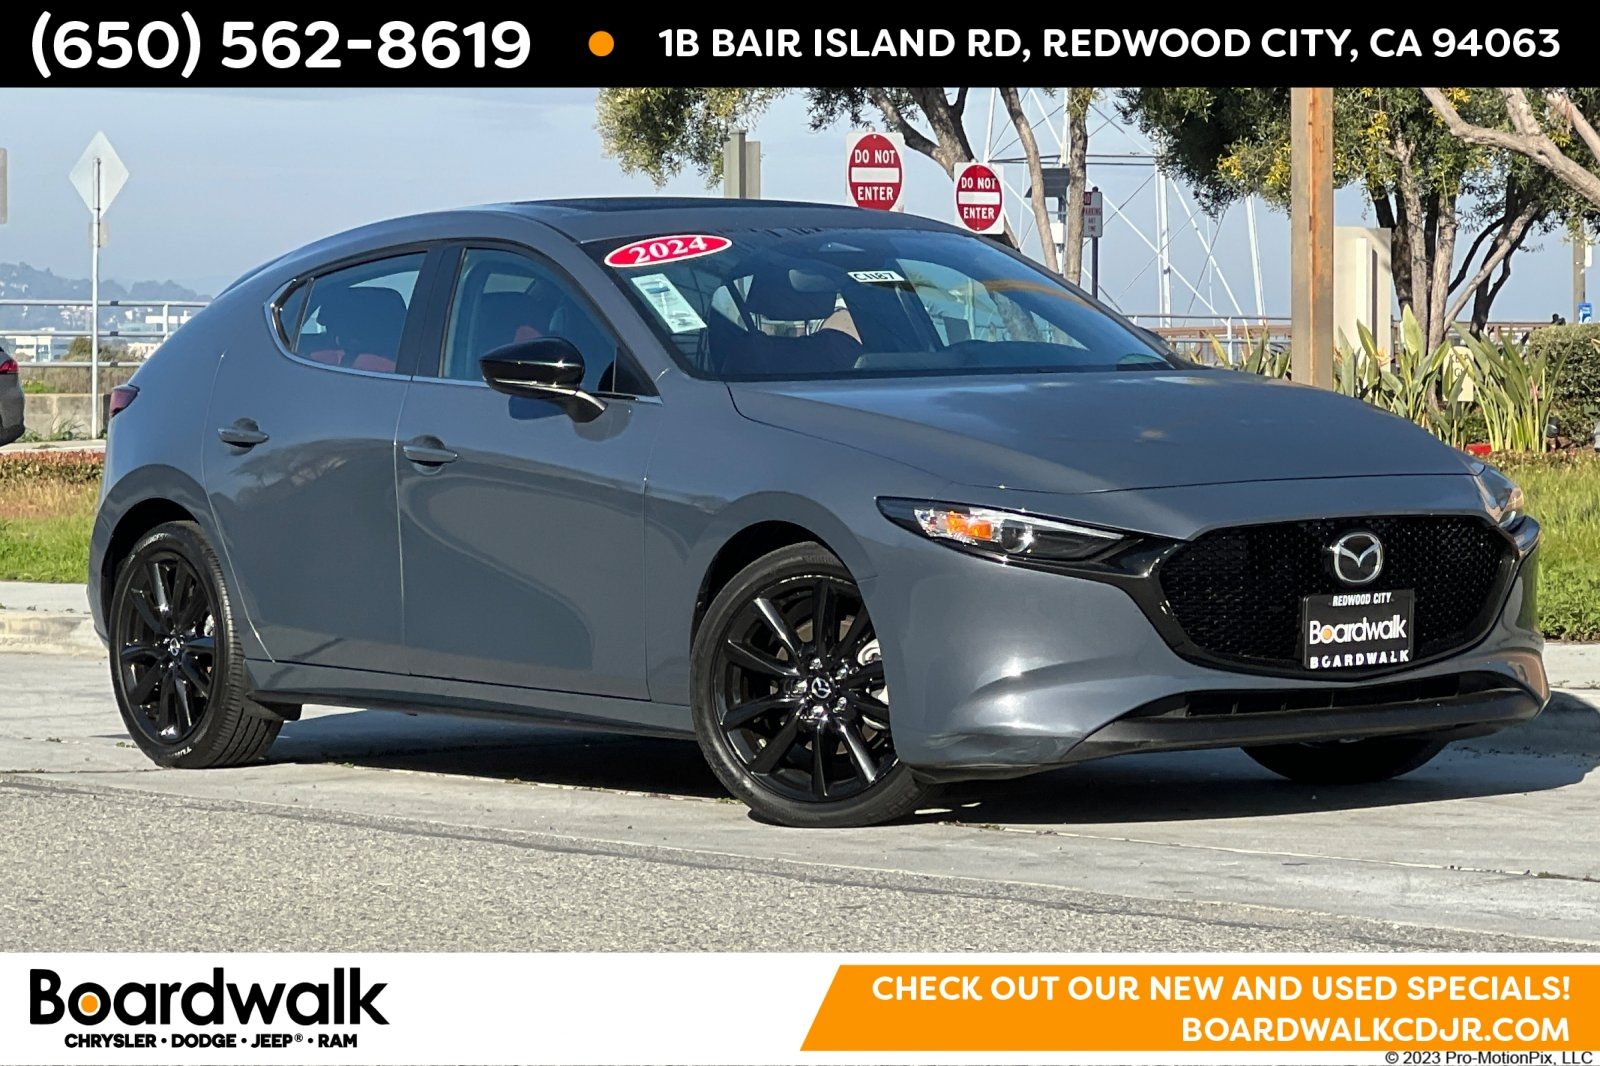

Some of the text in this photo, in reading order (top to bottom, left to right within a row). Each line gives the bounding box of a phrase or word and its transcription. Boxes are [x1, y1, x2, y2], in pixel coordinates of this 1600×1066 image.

[854, 149, 896, 164] DO NOT
[961, 177, 997, 189] DO NOT
[857, 186, 894, 201] ENTER
[963, 207, 995, 219] ENTER
[628, 236, 708, 264] 2024
[1332, 592, 1392, 607] REDWOOD CITY
[1309, 614, 1407, 645] Boardwalk
[1310, 649, 1409, 669] BOARDWALK
